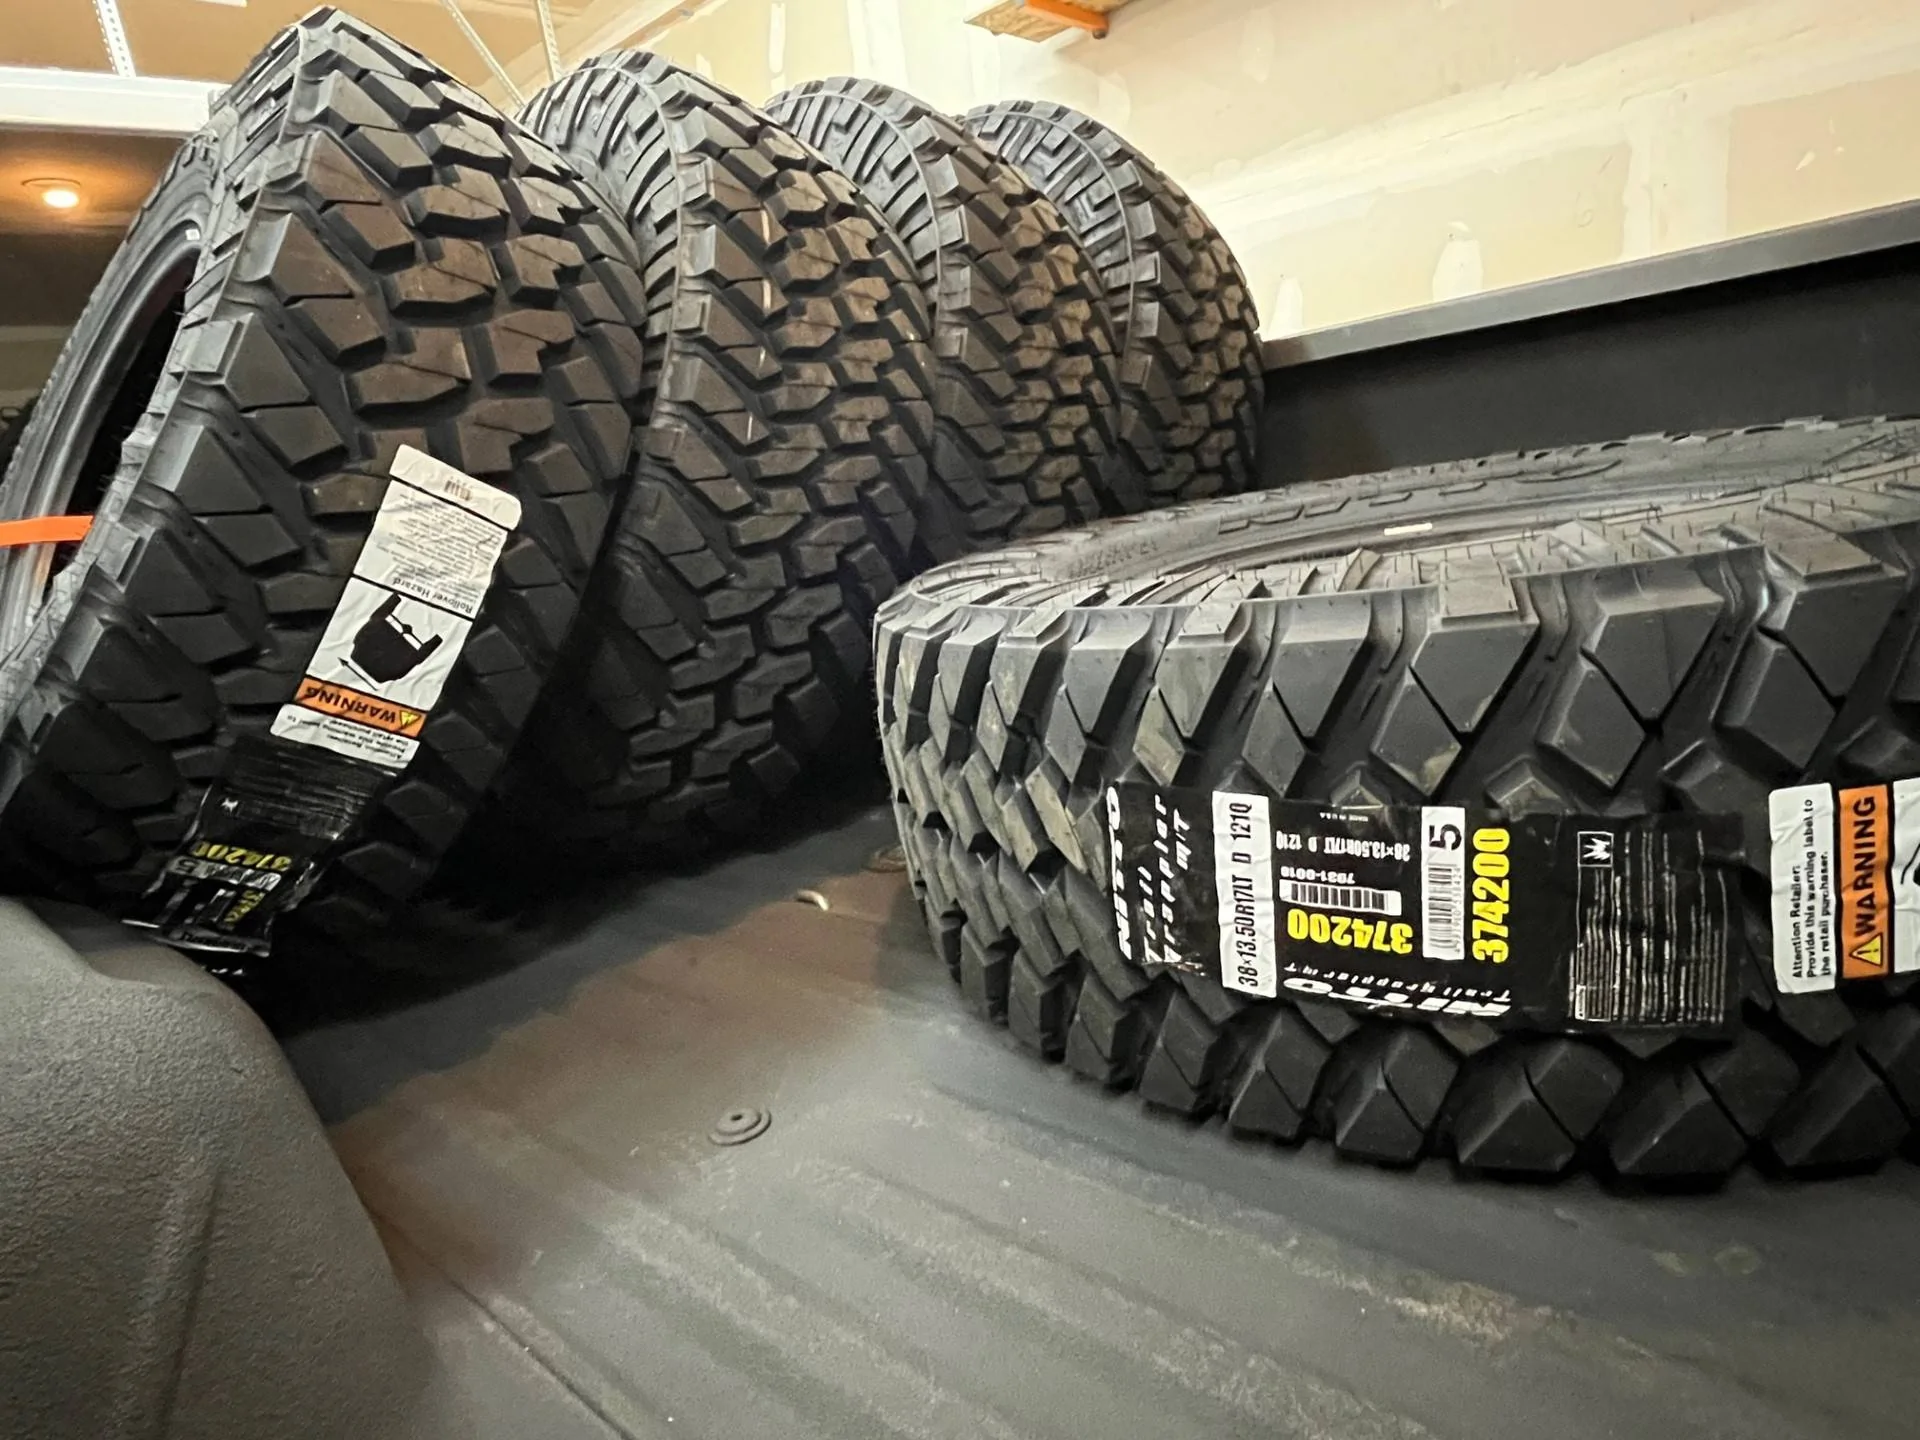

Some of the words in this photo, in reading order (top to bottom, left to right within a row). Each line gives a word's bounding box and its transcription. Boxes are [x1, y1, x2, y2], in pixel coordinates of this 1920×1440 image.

[391, 578, 430, 597] Hazard
[432, 593, 473, 614] Rollover
[306, 688, 396, 724] WARNING
[1229, 802, 1253, 840] 121Q
[1804, 799, 1813, 812] to
[1276, 831, 1302, 849] 121Q
[1308, 837, 1318, 852] D
[1429, 824, 1461, 851] 5
[1804, 816, 1813, 847] label
[1106, 786, 1132, 960] NITTO
[1232, 853, 1252, 864] D
[1806, 851, 1816, 902] warning
[1852, 796, 1876, 936] WARNING
[1472, 828, 1509, 963] 374200
[1790, 866, 1801, 917] Retailer:
[1820, 852, 1831, 916] purchaser.
[1138, 866, 1162, 962] Trail
[1287, 908, 1413, 954] 374200
[1805, 906, 1815, 927] this
[1792, 922, 1802, 978] Attention
[1819, 920, 1830, 951] retail
[1807, 932, 1816, 978] Provide
[1820, 956, 1831, 976] the
[1283, 977, 1511, 1016] NITTO
[1443, 986, 1511, 1002] Trail
